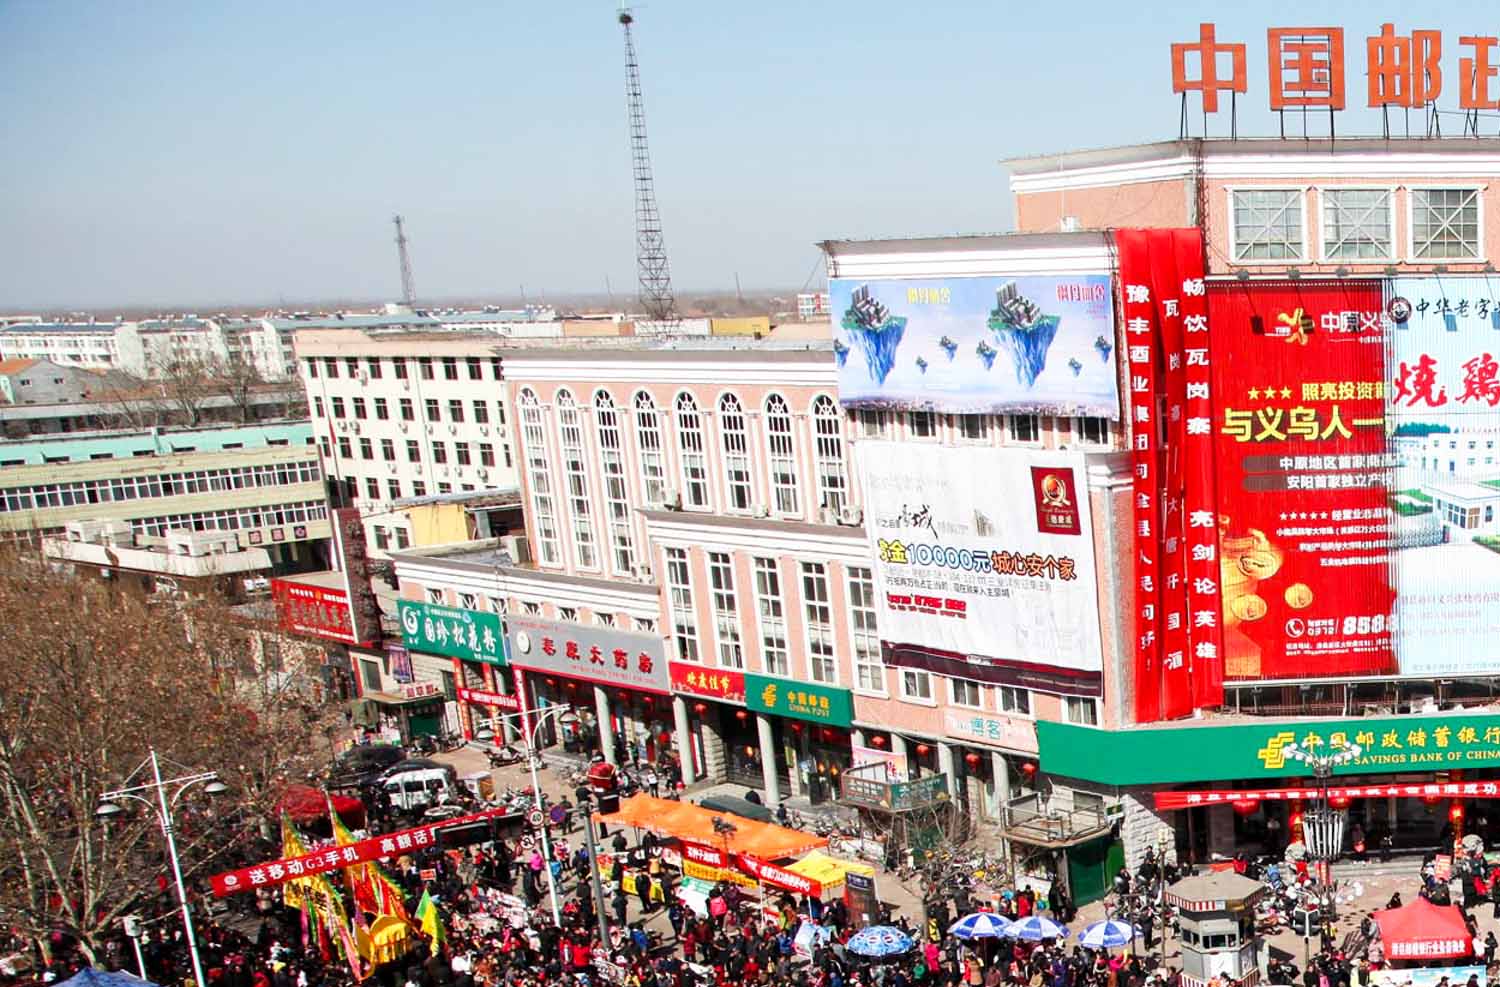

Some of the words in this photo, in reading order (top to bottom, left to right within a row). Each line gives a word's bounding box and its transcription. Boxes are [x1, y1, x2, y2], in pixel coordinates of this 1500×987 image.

[1183, 278, 1211, 435] 畅饮瓦岗寨
[992, 550, 1077, 581] 城心安个家
[1189, 510, 1217, 660] 亮剑论英雄
[1354, 753, 1406, 767] SAVINGS
[1410, 751, 1444, 763] BANK
[1447, 750, 1463, 762] OF
[248, 845, 360, 886] 送移动G3手机
